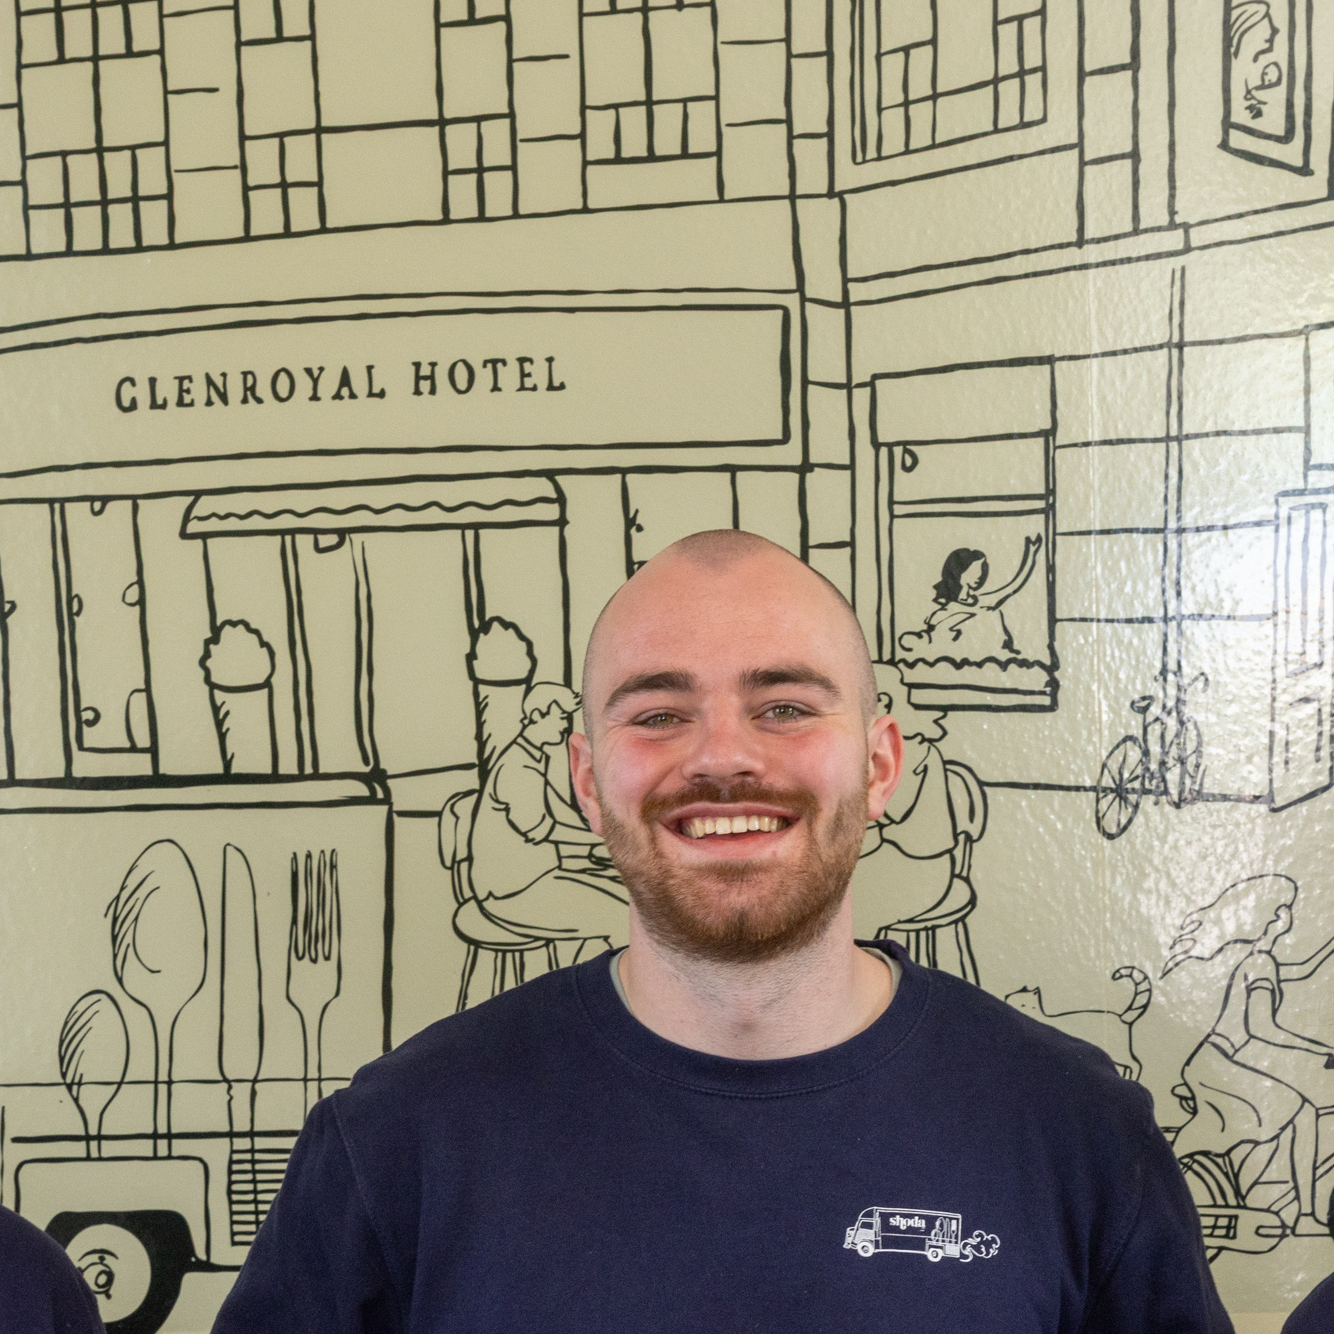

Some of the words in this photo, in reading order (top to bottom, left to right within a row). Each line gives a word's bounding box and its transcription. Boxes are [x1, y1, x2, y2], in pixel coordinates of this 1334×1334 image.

[115, 365, 387, 413] GLENROYAL
[411, 356, 566, 396] HOTEL
[889, 1215, 926, 1230] shoda
